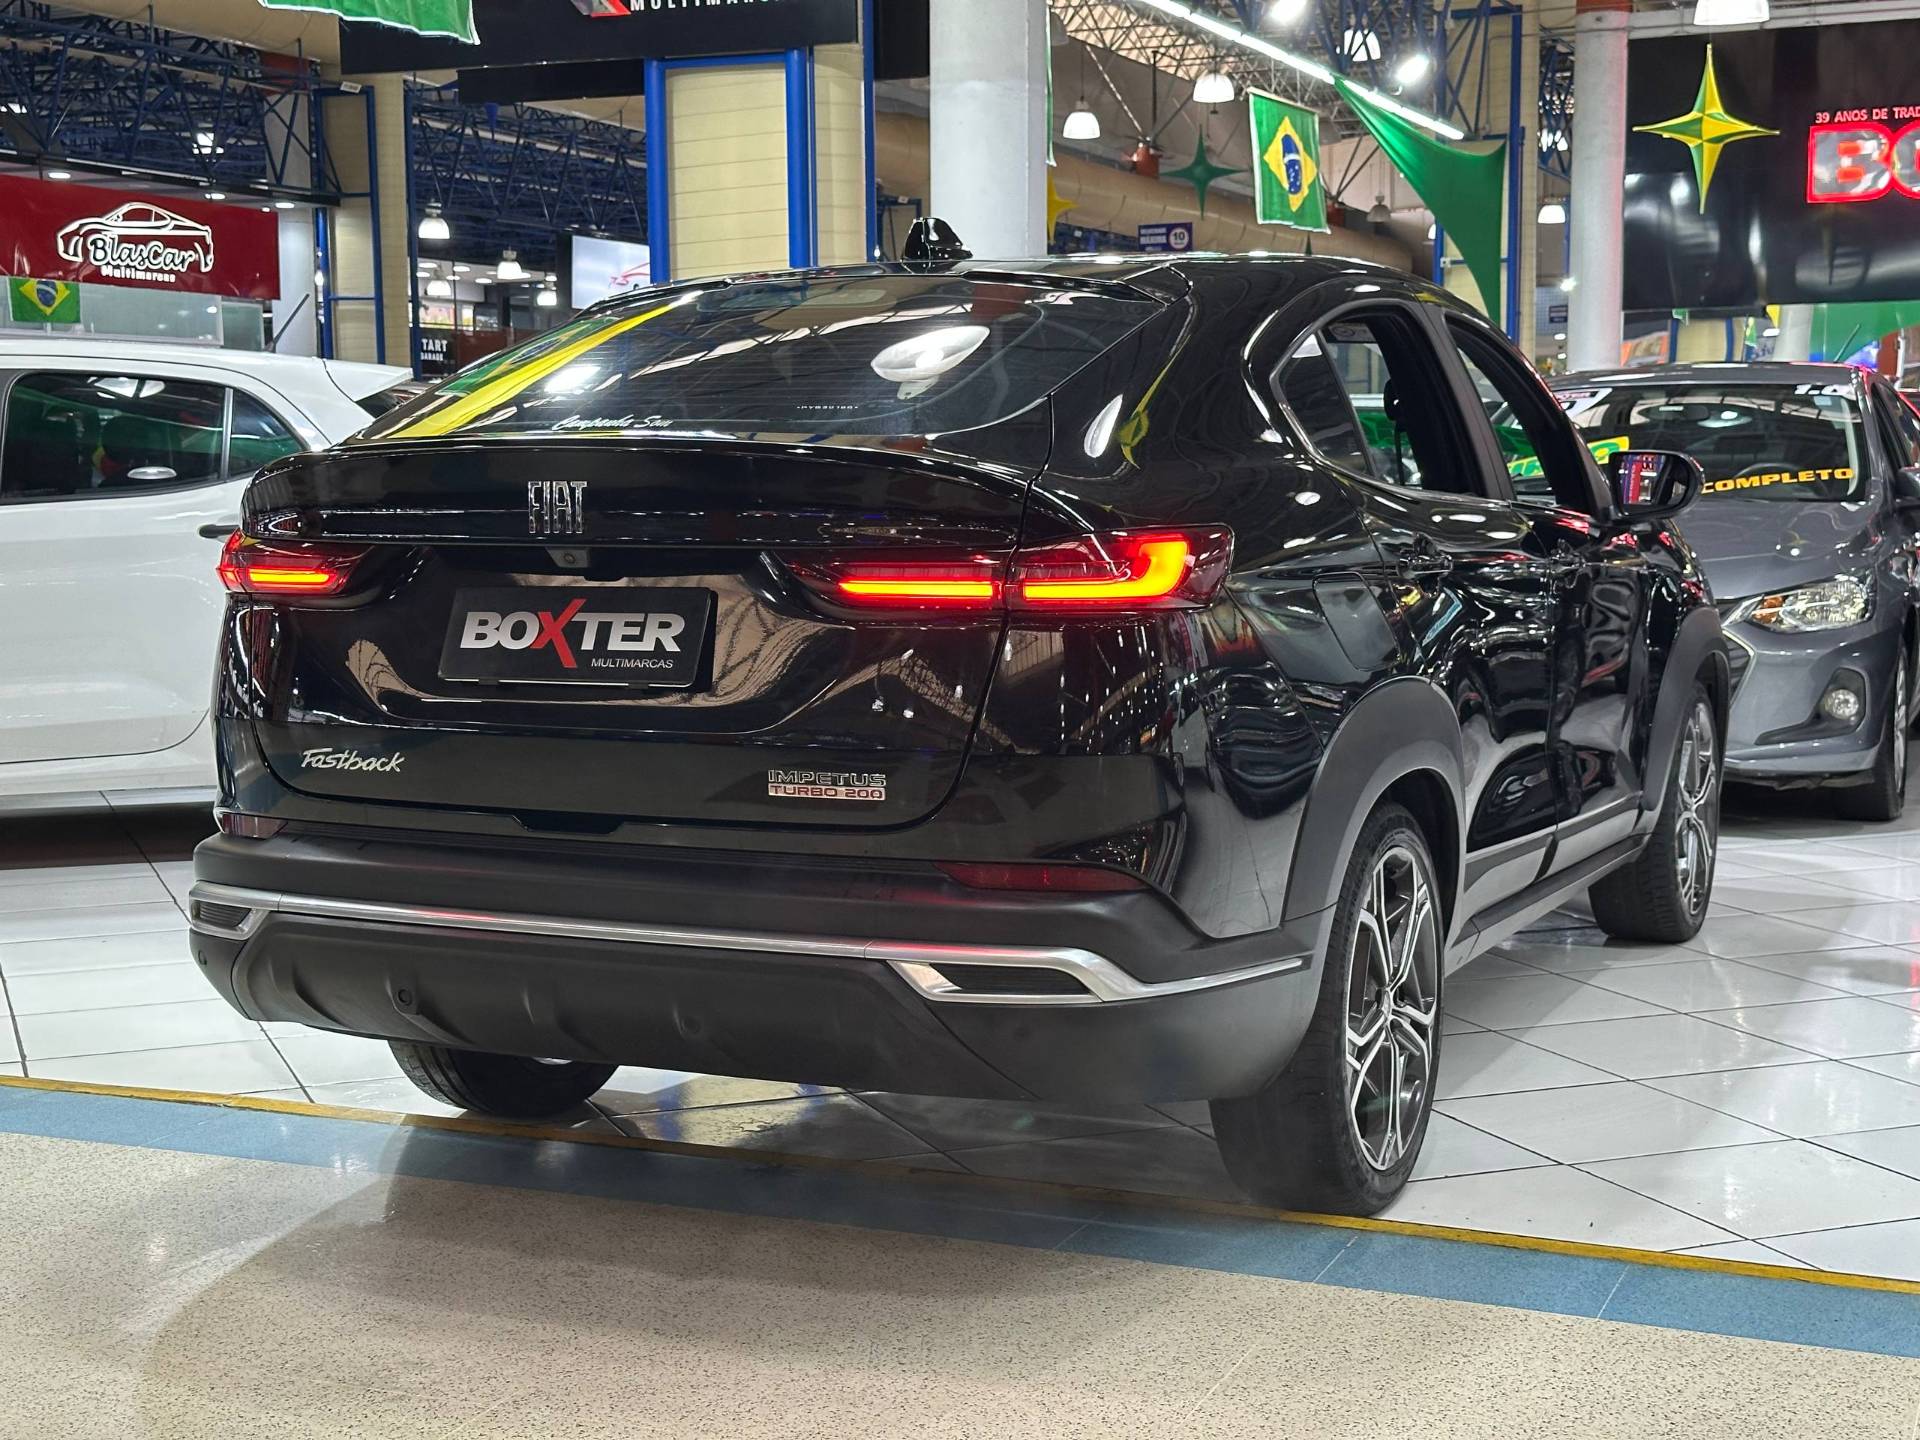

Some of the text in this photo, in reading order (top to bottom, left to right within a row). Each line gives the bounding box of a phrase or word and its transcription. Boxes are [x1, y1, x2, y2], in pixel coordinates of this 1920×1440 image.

[1815, 112, 1830, 124] 39
[1834, 109, 1868, 123] ANOS
[1872, 108, 1888, 120] DE
[1172, 231, 1186, 241] 10
[87, 233, 196, 272] BlasCar
[1701, 467, 1855, 495] COMPLETO
[528, 481, 588, 534] FIAT
[459, 599, 686, 669] BOXTER
[591, 657, 674, 669] MULTIMARCAS
[301, 747, 405, 773] Fastback
[768, 769, 887, 787] IMPETUS
[770, 785, 883, 799] TURBO 200
